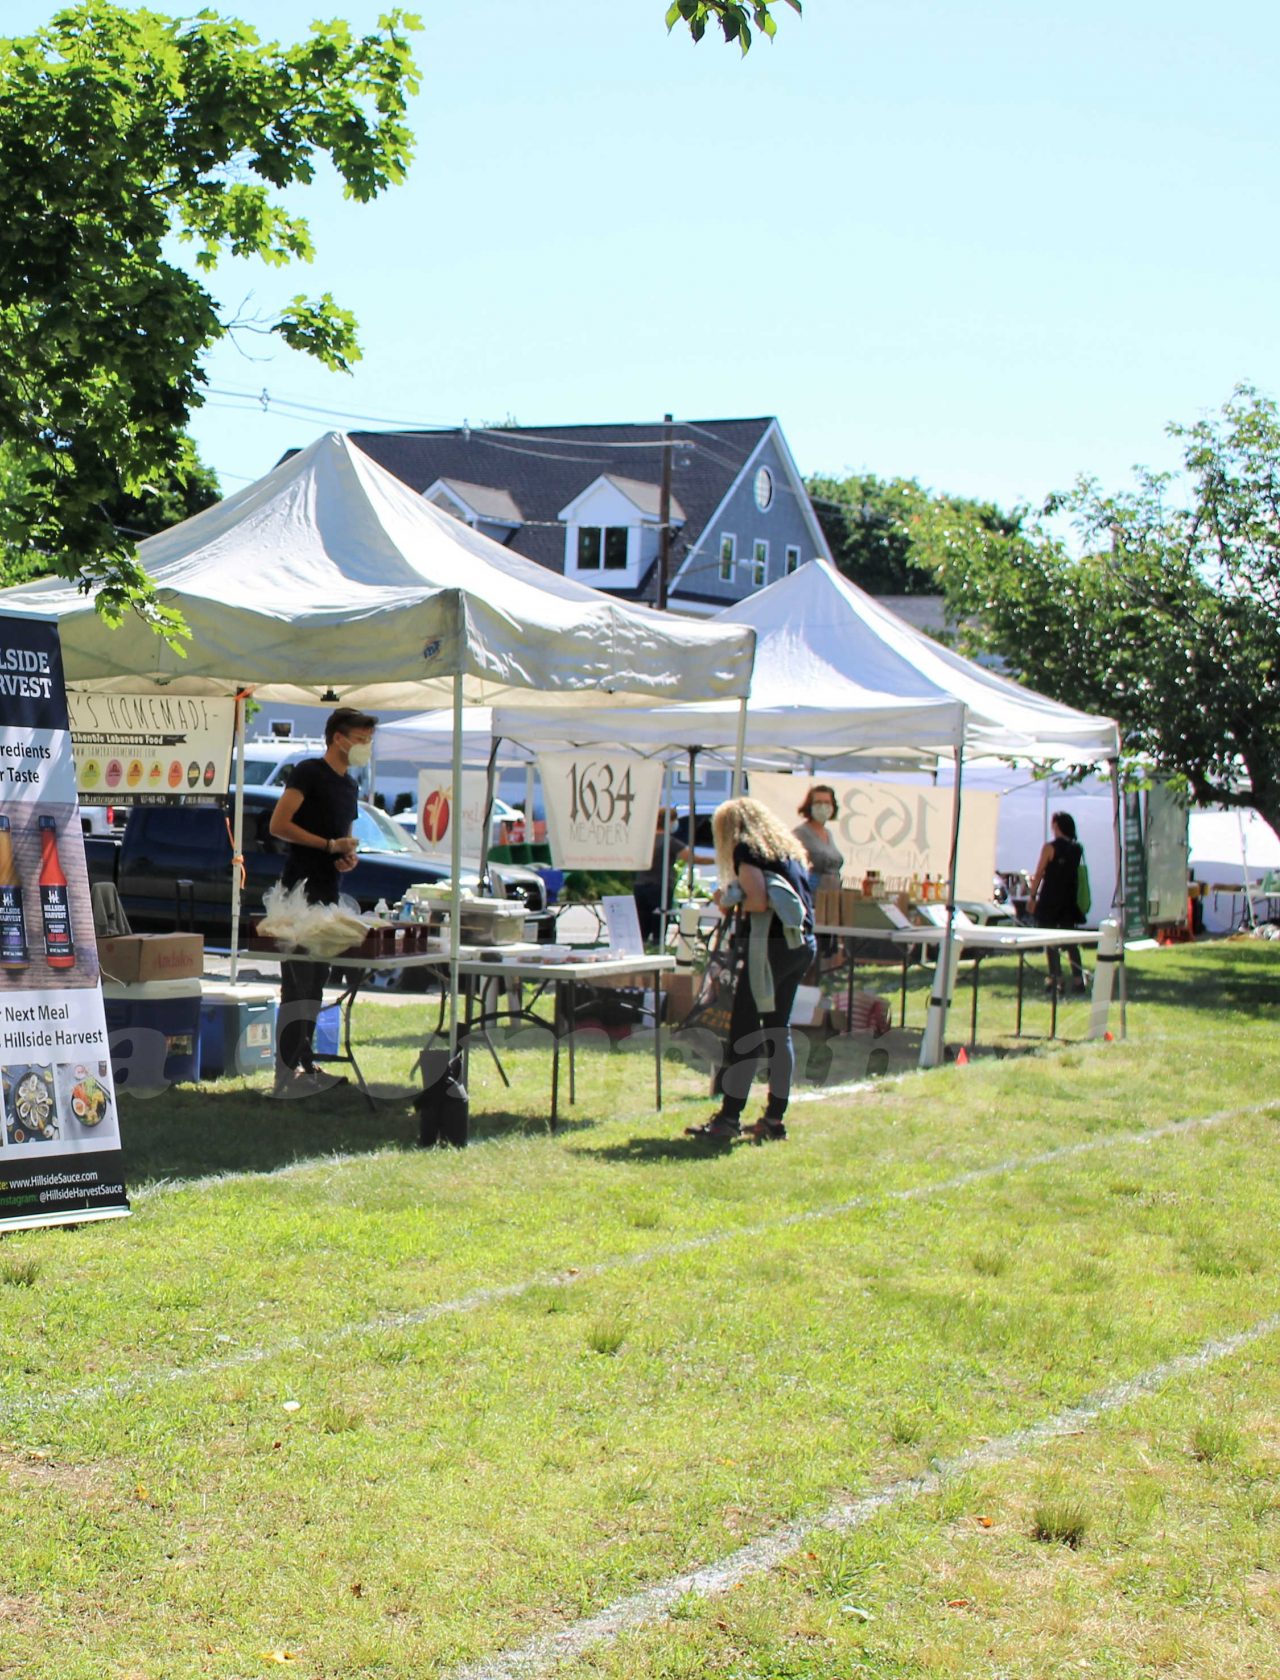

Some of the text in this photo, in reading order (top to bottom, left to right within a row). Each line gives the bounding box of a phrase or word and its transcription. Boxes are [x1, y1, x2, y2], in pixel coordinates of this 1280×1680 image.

[107, 697, 209, 731] HOMEMADE
[145, 735, 164, 745] Food
[7, 767, 40, 783] Taste
[566, 761, 635, 825] 1634
[569, 821, 632, 847] MEADERY
[5, 1006, 35, 1022] Next
[38, 1003, 69, 1020] Meal
[4, 1031, 52, 1048] Hillside
[55, 1029, 103, 1046] Harvest
[9, 1171, 98, 1190] www.HillsideSauce.com
[39, 1184, 123, 1203] @HillsideHarvestSauce
